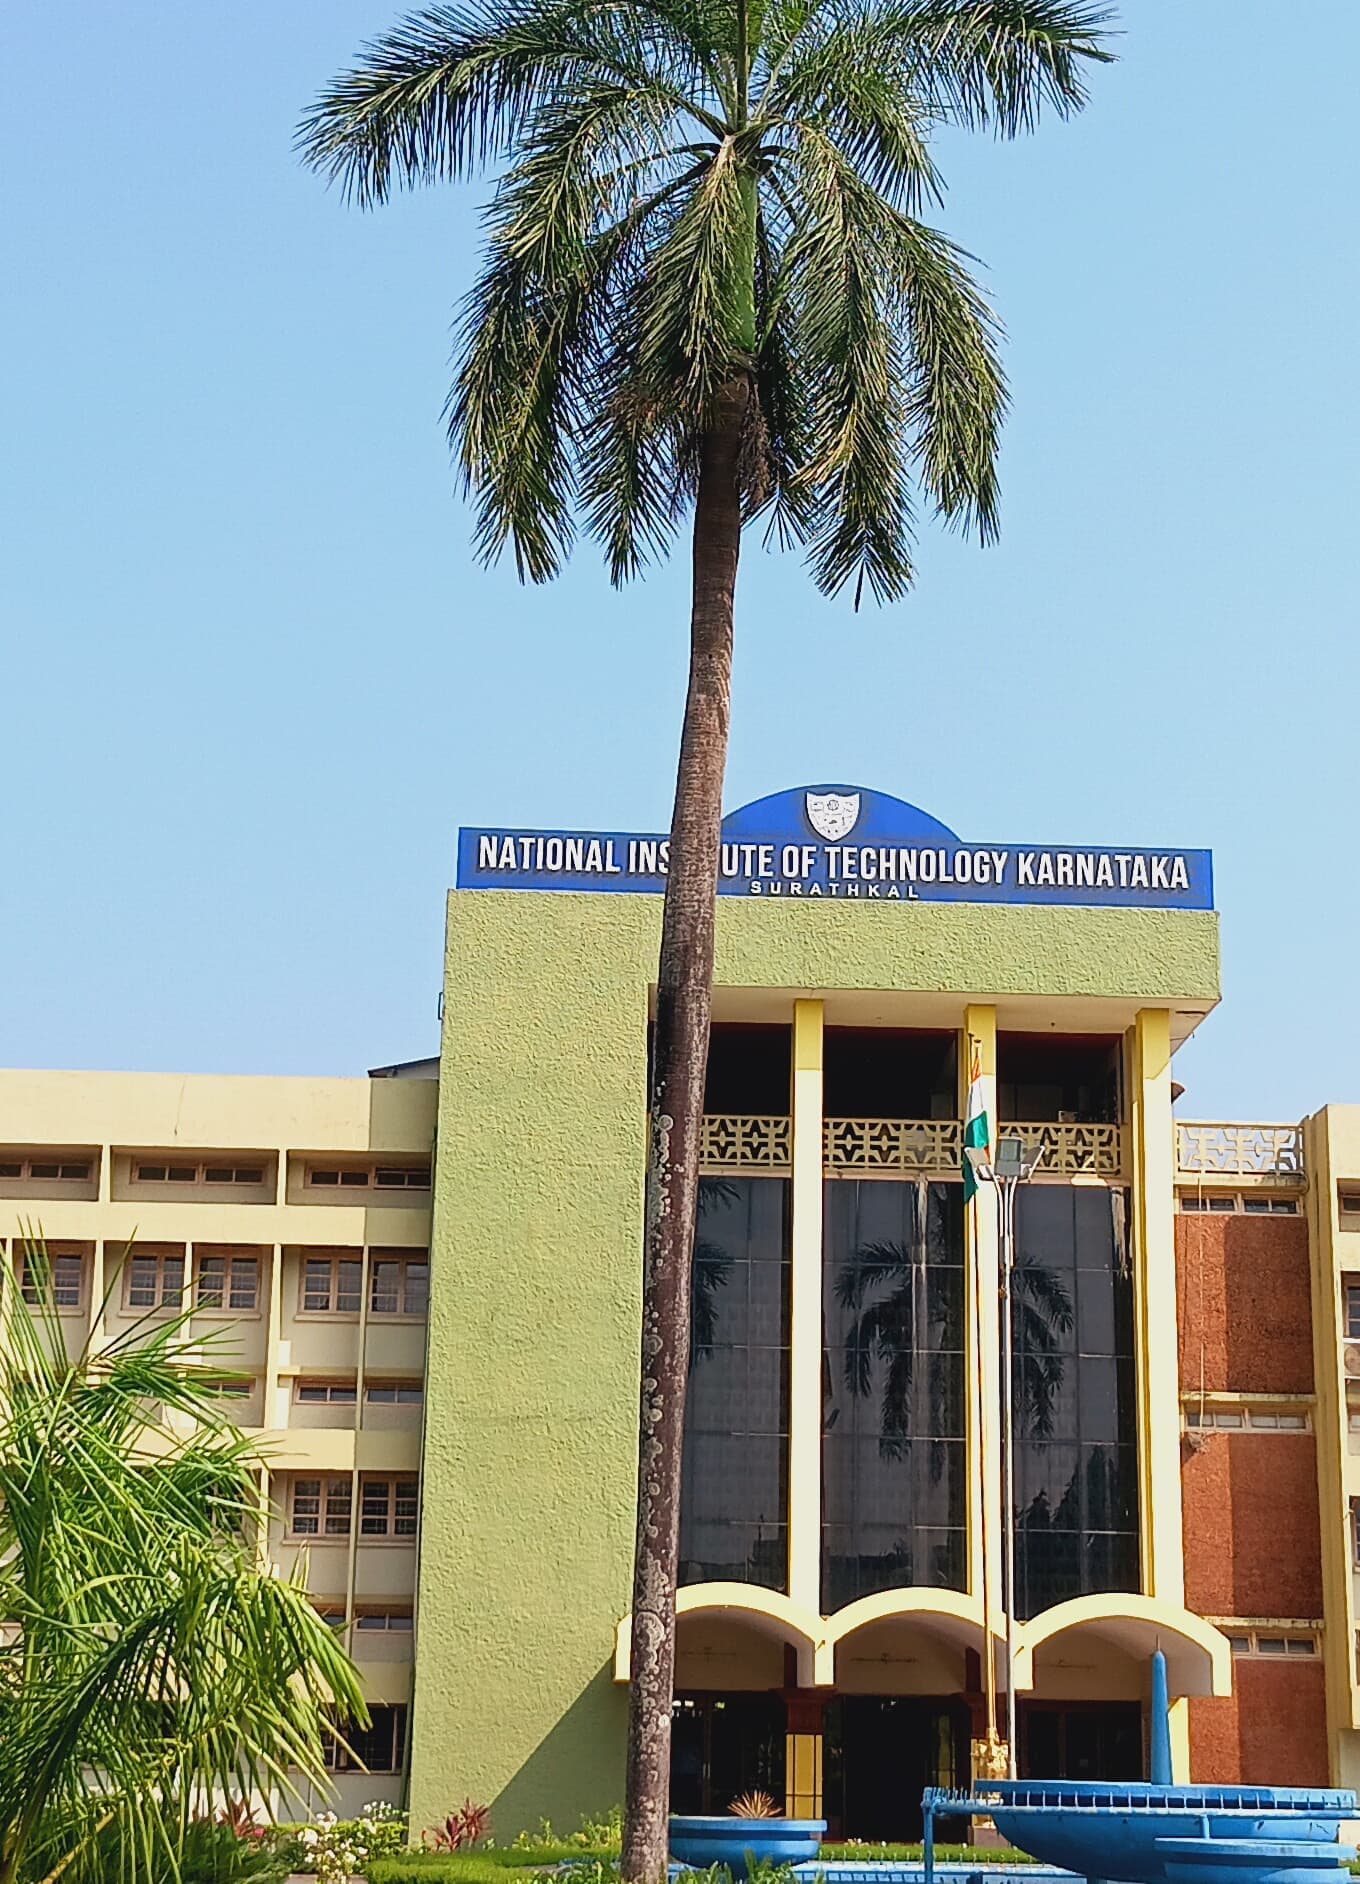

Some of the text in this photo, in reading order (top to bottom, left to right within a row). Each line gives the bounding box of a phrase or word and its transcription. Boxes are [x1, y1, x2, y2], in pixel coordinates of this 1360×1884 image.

[478, 835, 1189, 889] NATIONAL INSUTE OF TECHNOLOGY KARNATAKA
[750, 881, 920, 899] SURATHKAL
